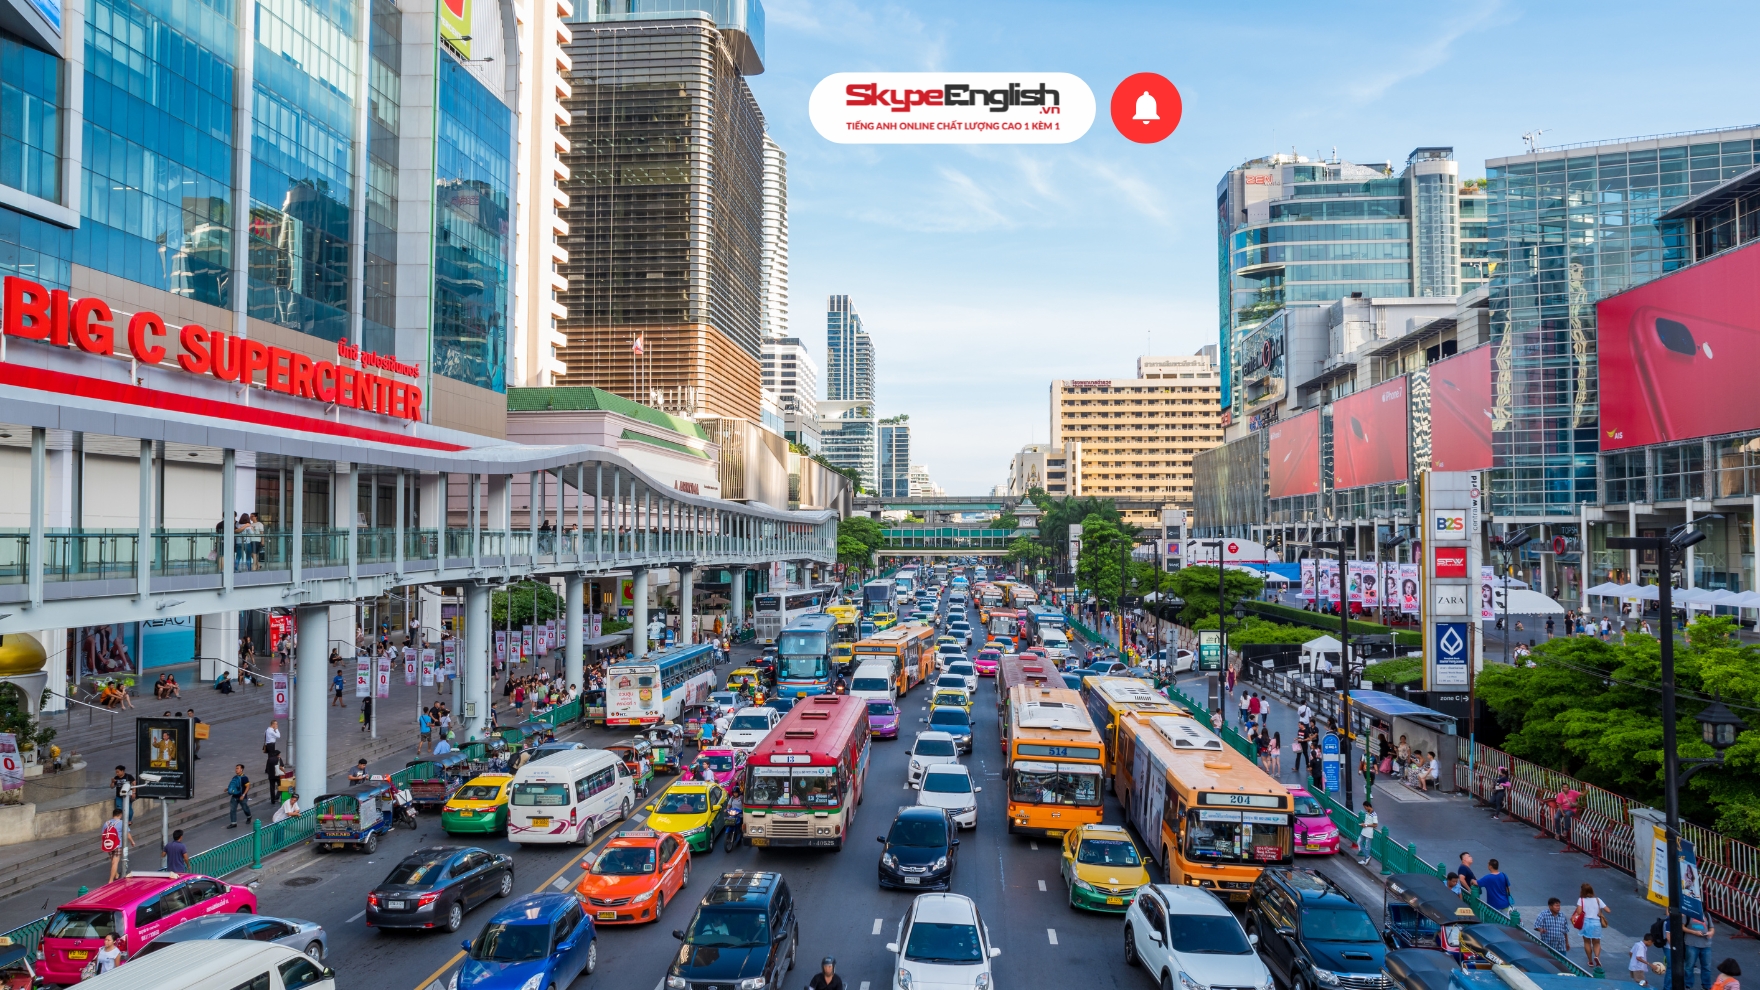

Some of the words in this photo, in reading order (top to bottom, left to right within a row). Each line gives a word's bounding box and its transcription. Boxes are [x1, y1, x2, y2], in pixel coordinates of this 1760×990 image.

[4, 275, 114, 356] BIG
[128, 311, 166, 364] C
[177, 323, 422, 422] SUPERCENTER
[1614, 432, 1624, 440] AIS
[1437, 517, 1464, 530] B2S
[1049, 747, 1067, 756] 514
[1230, 795, 1250, 804] 204
